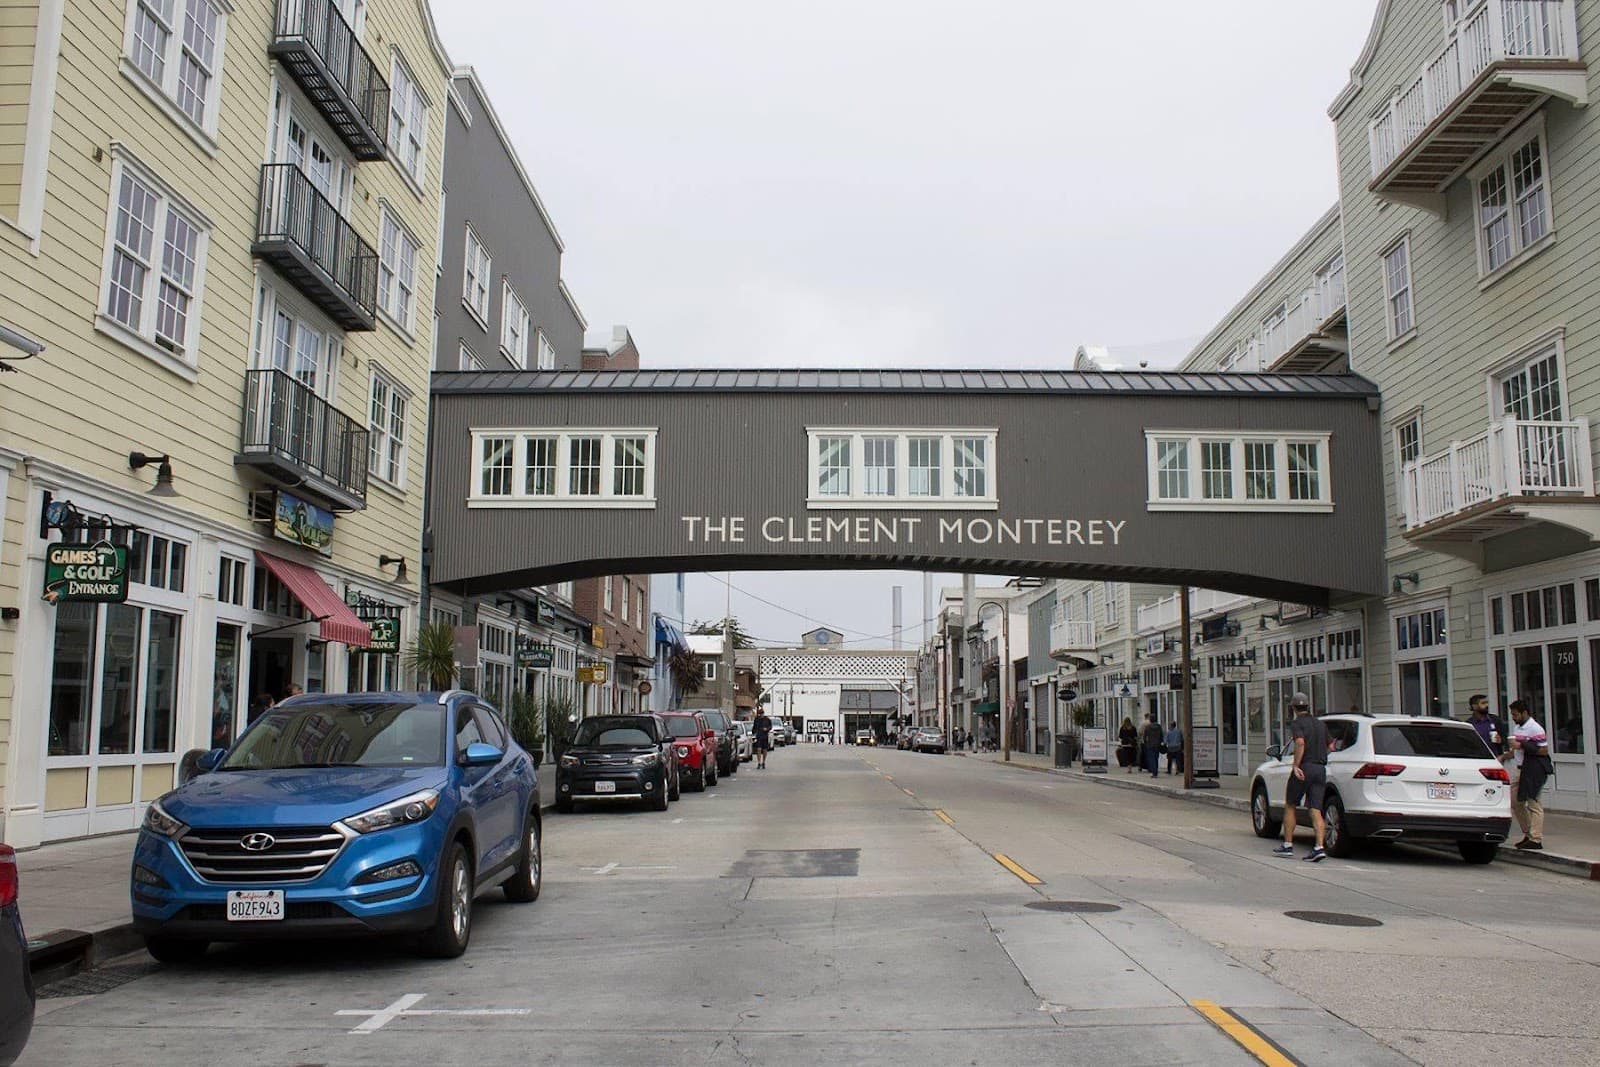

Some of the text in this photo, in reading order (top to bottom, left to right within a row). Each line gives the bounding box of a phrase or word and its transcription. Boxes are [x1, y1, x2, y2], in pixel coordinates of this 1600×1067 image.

[681, 516, 1126, 545] THE CLEMENT MONTEREY
[51, 550, 96, 564] GAMES
[63, 565, 114, 580] & GOLF
[69, 581, 119, 595] ENTRANCE
[1557, 652, 1574, 665] 750
[231, 901, 280, 915] 8DZF943
